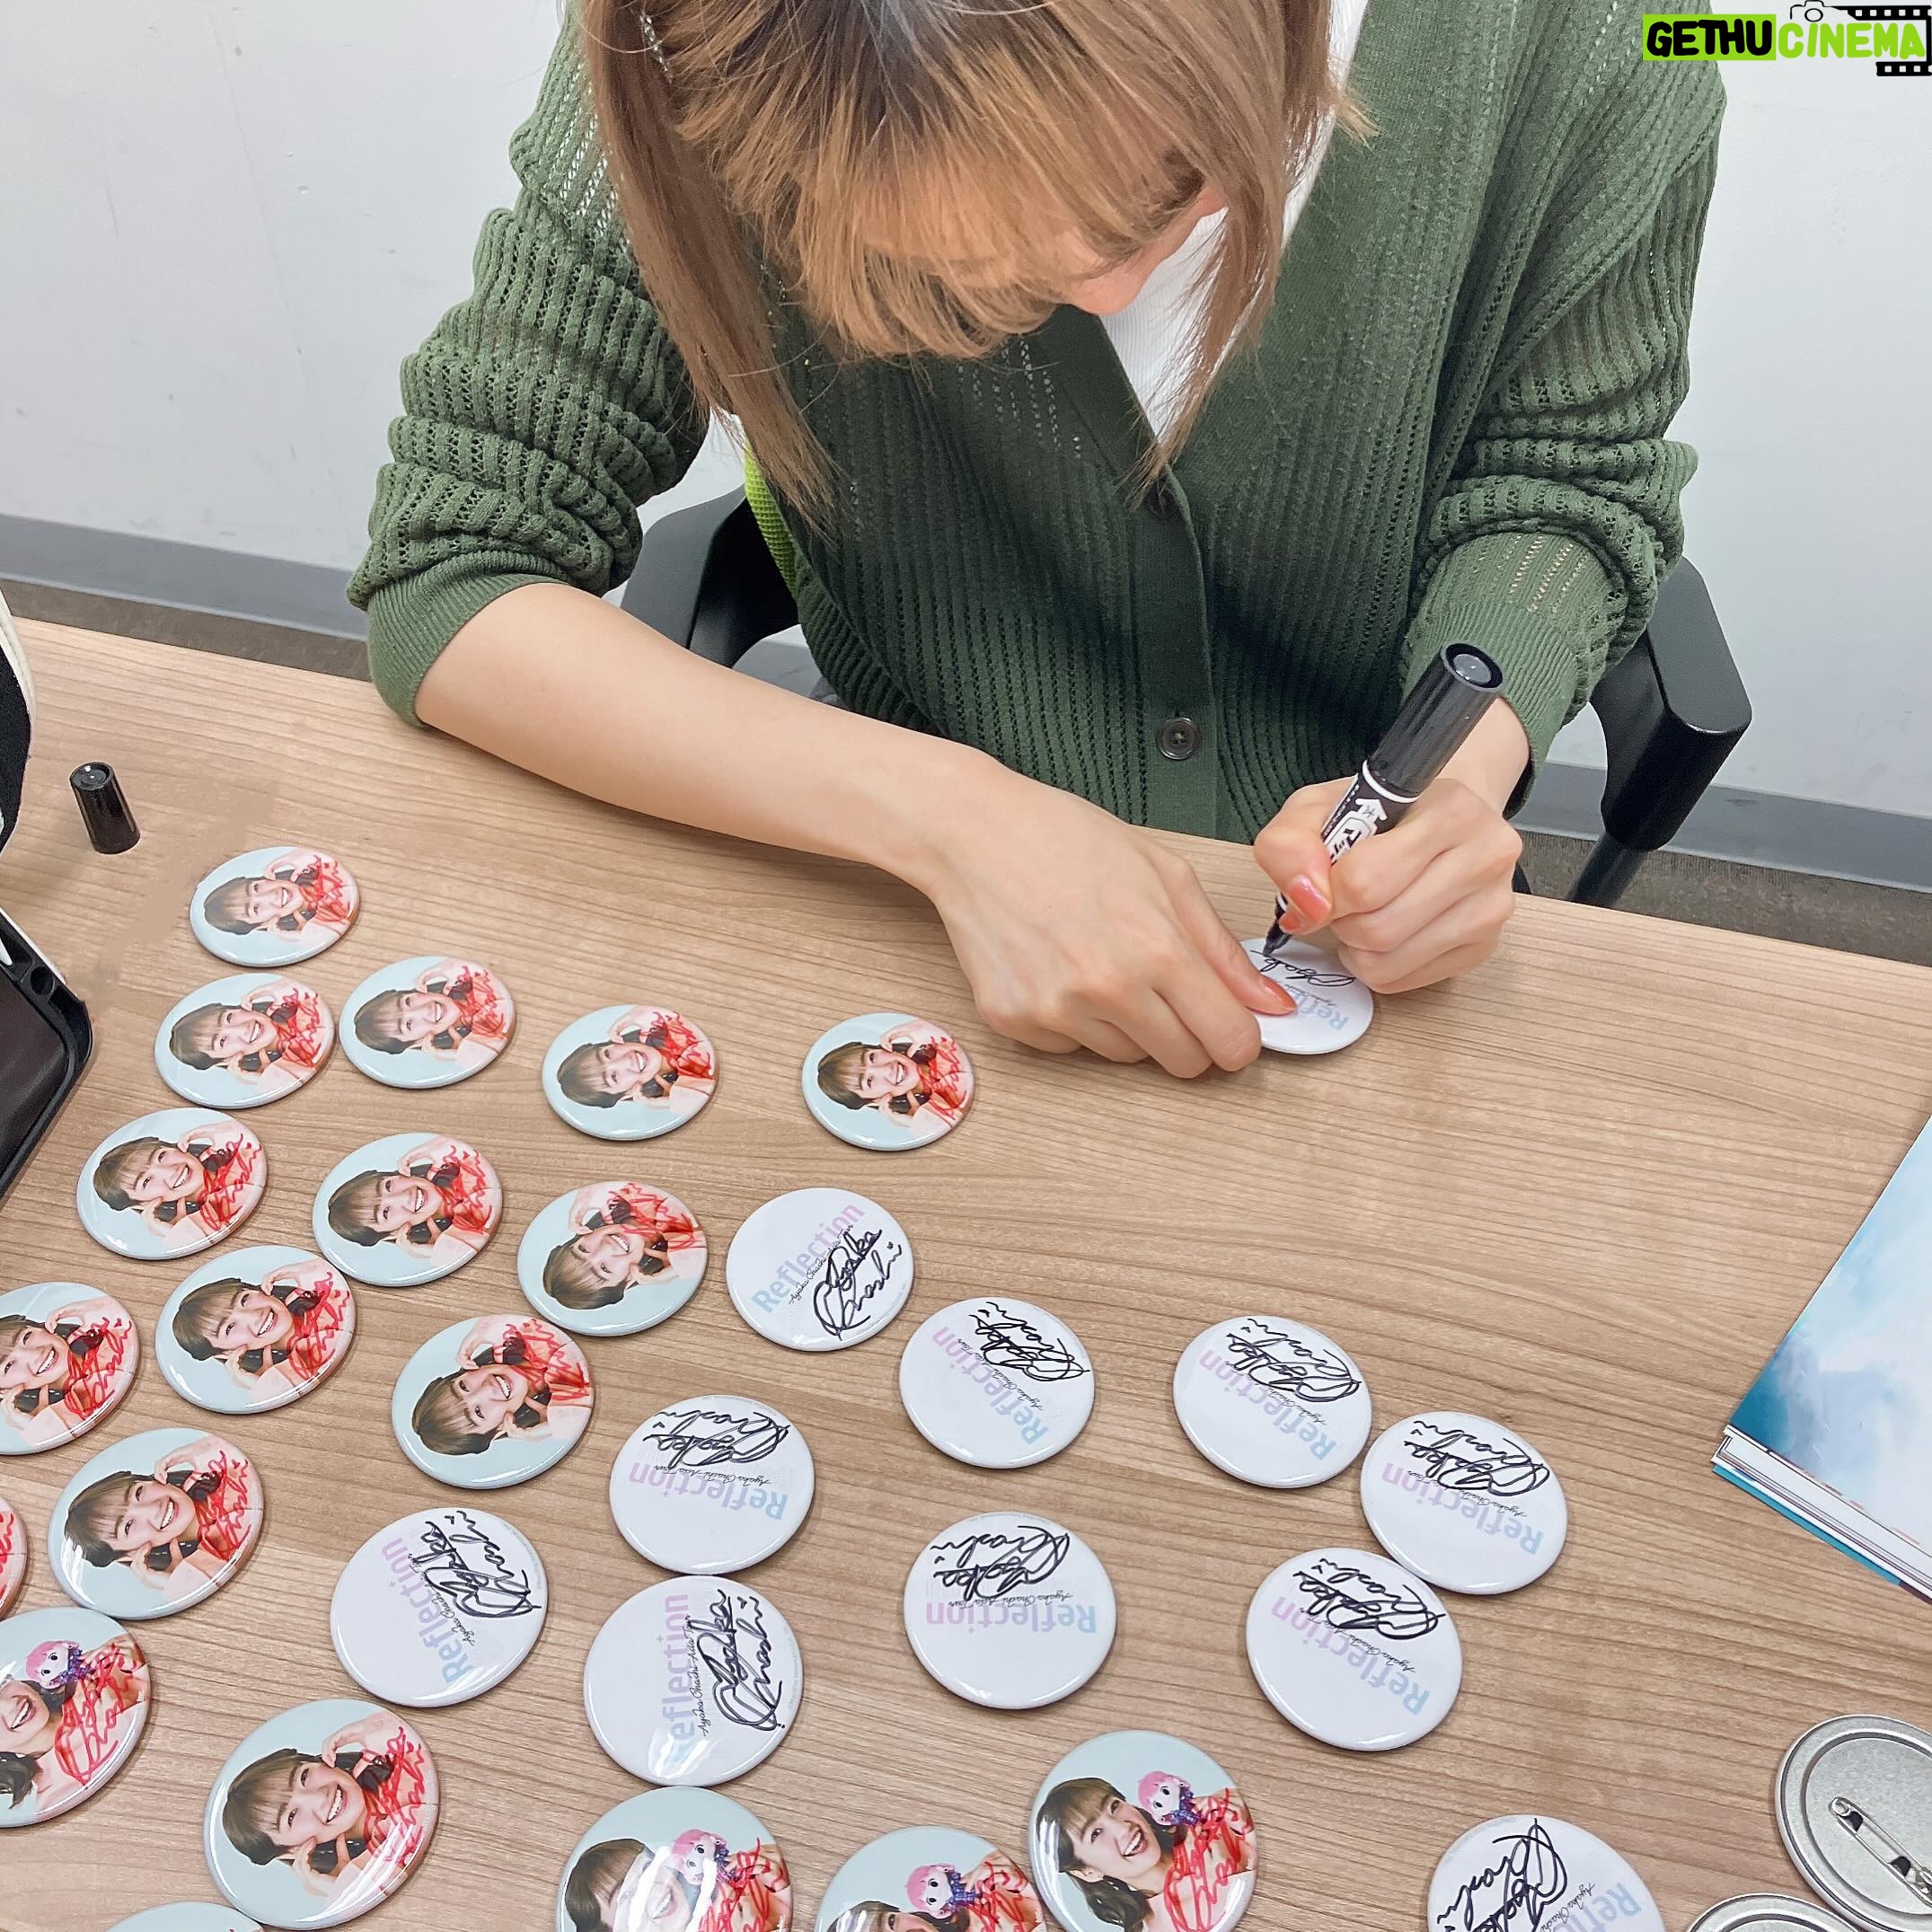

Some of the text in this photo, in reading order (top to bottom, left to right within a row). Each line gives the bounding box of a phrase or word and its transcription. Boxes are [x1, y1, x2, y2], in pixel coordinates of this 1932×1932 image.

[751, 1204, 865, 1312] Reflection
[932, 1327, 1049, 1444] Reflection
[1199, 1351, 1337, 1460] Reflection
[629, 1460, 788, 1520] Reflection
[1381, 1462, 1544, 1555] Reflection
[381, 1537, 474, 1683] Reflection
[926, 1601, 1096, 1633] Reflection
[1272, 1597, 1430, 1716] Reflection
[662, 1594, 697, 1763] eflection
